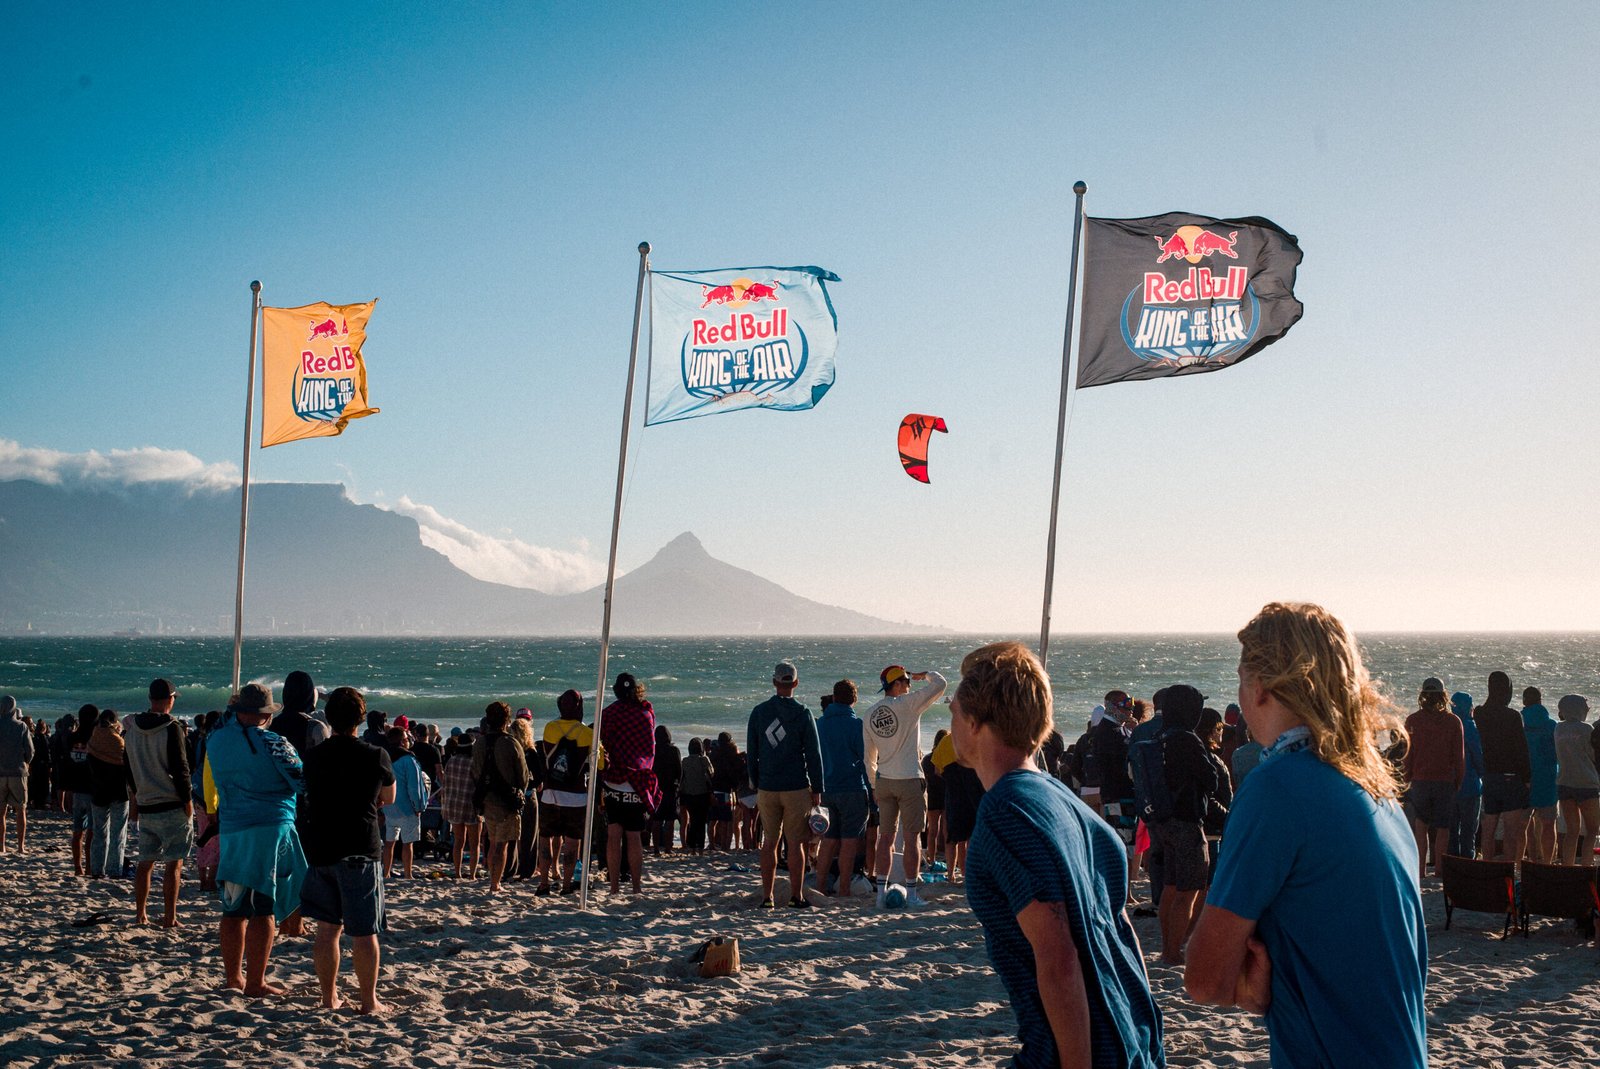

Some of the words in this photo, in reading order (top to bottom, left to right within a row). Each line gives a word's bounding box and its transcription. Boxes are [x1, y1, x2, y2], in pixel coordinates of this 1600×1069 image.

[1144, 267, 1197, 303] Red
[1199, 266, 1248, 299] Bull
[693, 314, 736, 345] Red
[740, 309, 787, 340] Bull
[1134, 309, 1188, 348] KING
[1194, 310, 1207, 325] OF
[1189, 325, 1210, 341] THE
[302, 347, 341, 374] Red
[688, 350, 731, 389] KING
[733, 365, 749, 380] THE
[735, 352, 748, 365] OF
[753, 342, 795, 381] AIR
[298, 379, 336, 413] KING
[340, 379, 351, 391] OF
[872, 715, 894, 728] VANS
